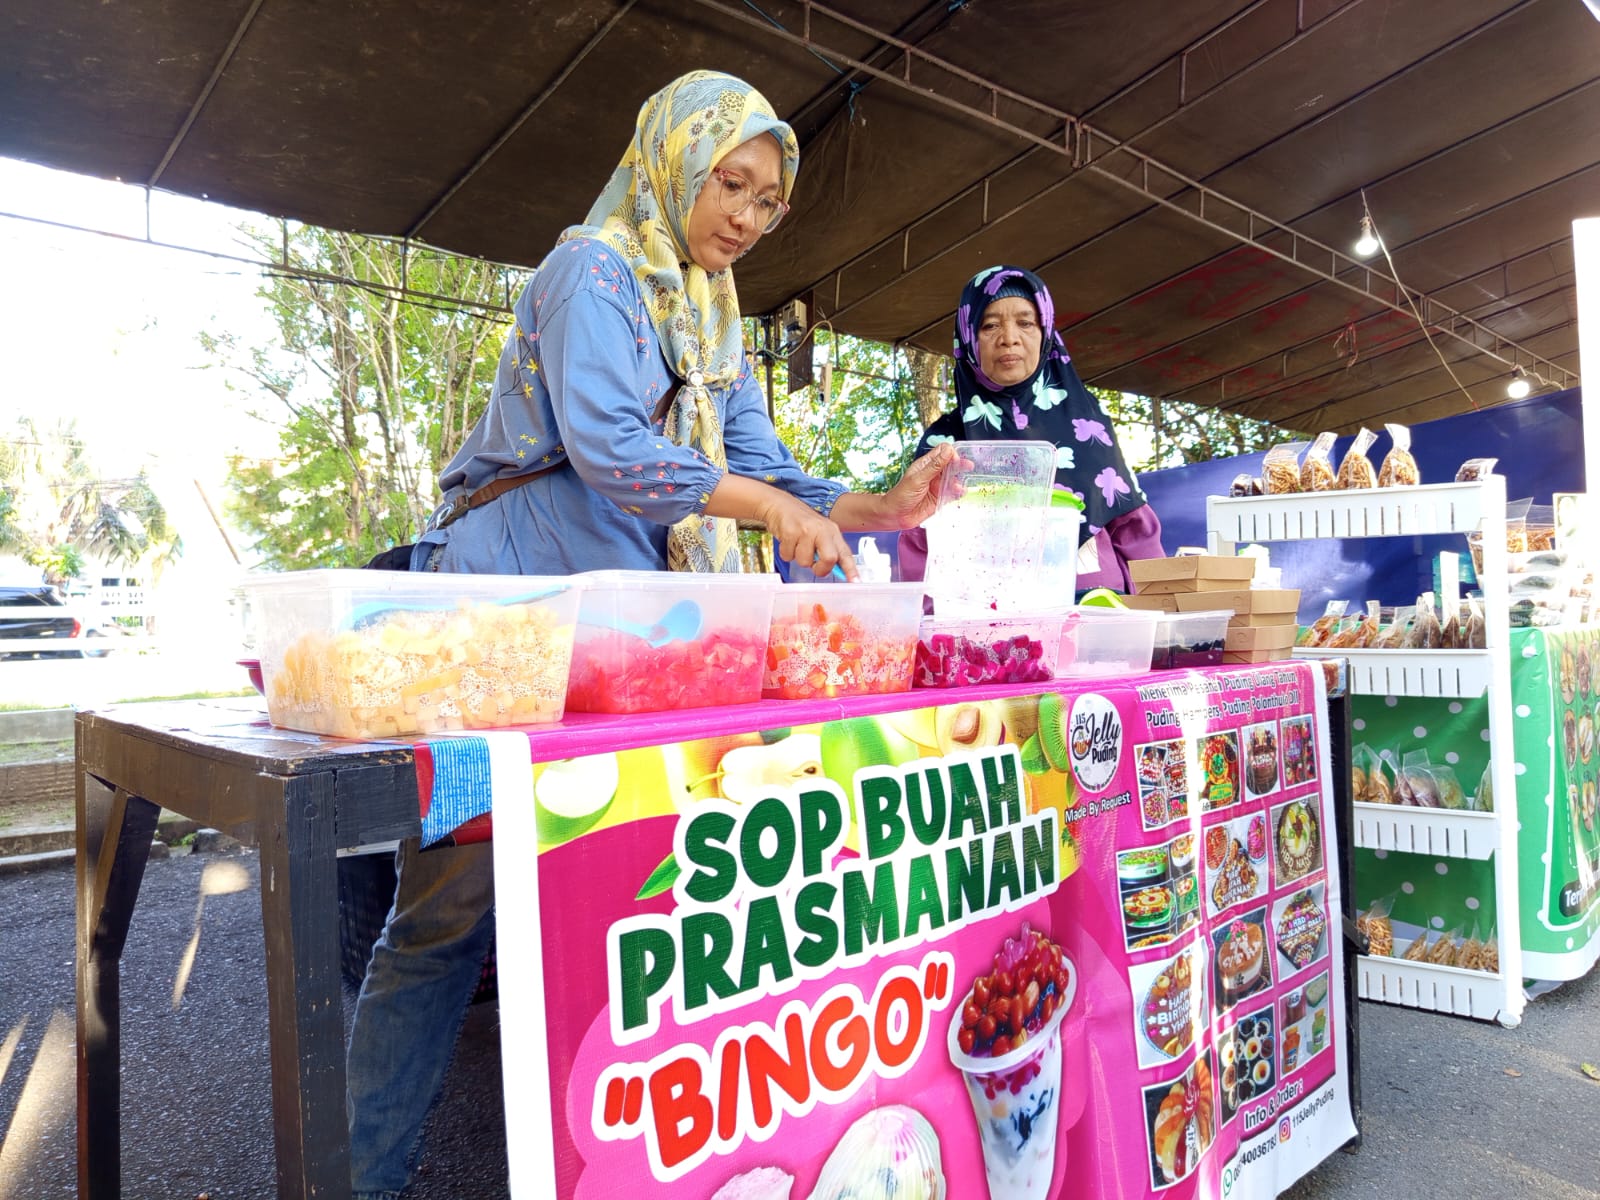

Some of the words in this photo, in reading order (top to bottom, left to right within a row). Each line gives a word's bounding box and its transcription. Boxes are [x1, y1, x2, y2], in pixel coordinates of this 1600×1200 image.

[1139, 684, 1188, 701] Menerima
[1223, 676, 1253, 690] Puding
[1255, 673, 1275, 687] Ulang
[1075, 712, 1086, 725] 115
[1146, 711, 1181, 726] Puding
[1223, 701, 1251, 714] Puding
[1074, 711, 1121, 756] Jelly
[1092, 746, 1118, 765] Puding
[1065, 805, 1087, 823] Made
[1088, 801, 1100, 816] By
[1101, 791, 1132, 813] Request
[684, 789, 843, 903] SOP
[859, 753, 1021, 861] BUAH
[619, 818, 1055, 1031] PRASMANAN
[1245, 1105, 1267, 1129] Info
[1268, 1099, 1275, 1116] &
